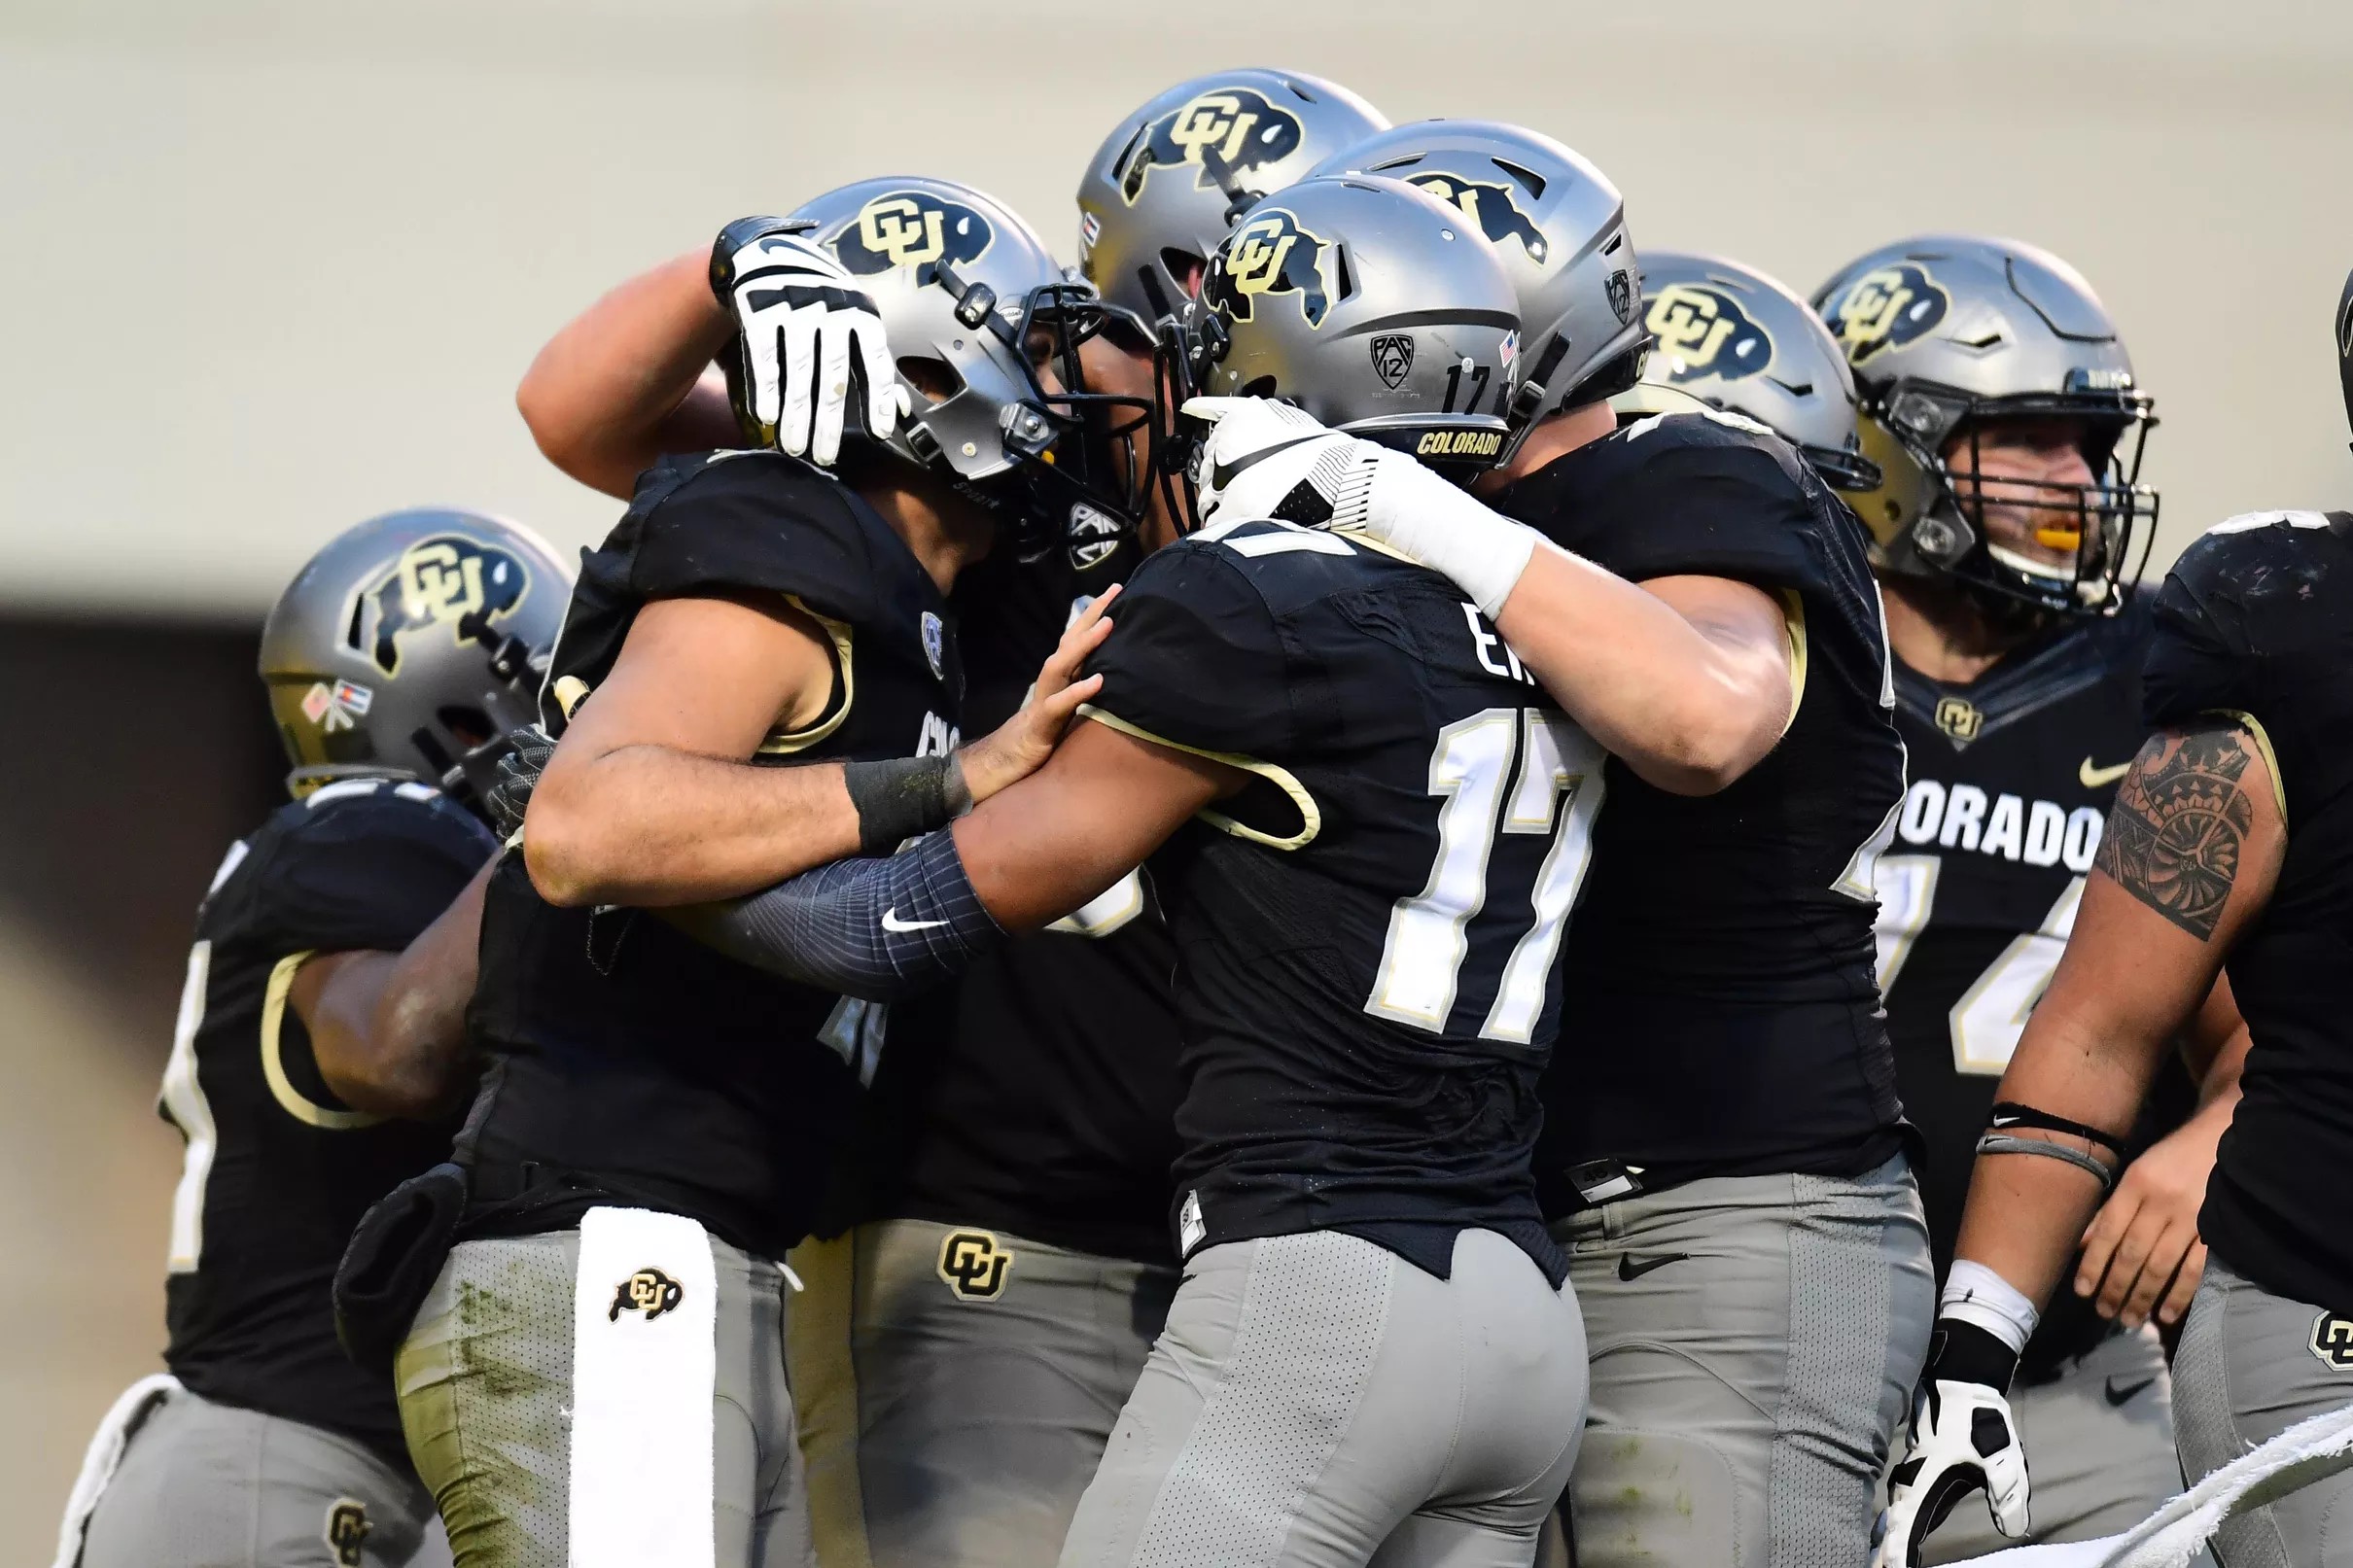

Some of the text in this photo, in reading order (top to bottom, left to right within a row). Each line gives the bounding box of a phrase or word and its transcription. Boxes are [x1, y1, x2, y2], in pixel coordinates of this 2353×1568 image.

[1170, 96, 1258, 163] CU
[859, 198, 944, 264] CU
[1225, 218, 1298, 294] CU
[1645, 285, 1736, 367] CU
[1839, 269, 1914, 341] CU
[1373, 336, 1412, 367] PAC
[1383, 357, 1403, 377] 12
[1441, 364, 1491, 415] 17
[1417, 432, 1502, 456] COLORADO
[401, 544, 484, 620] CU
[1936, 697, 1983, 742] CU
[1898, 779, 2105, 872] ORADO
[1363, 707, 1608, 1046] 17
[630, 1273, 667, 1309] CU
[943, 1233, 1007, 1296] CU
